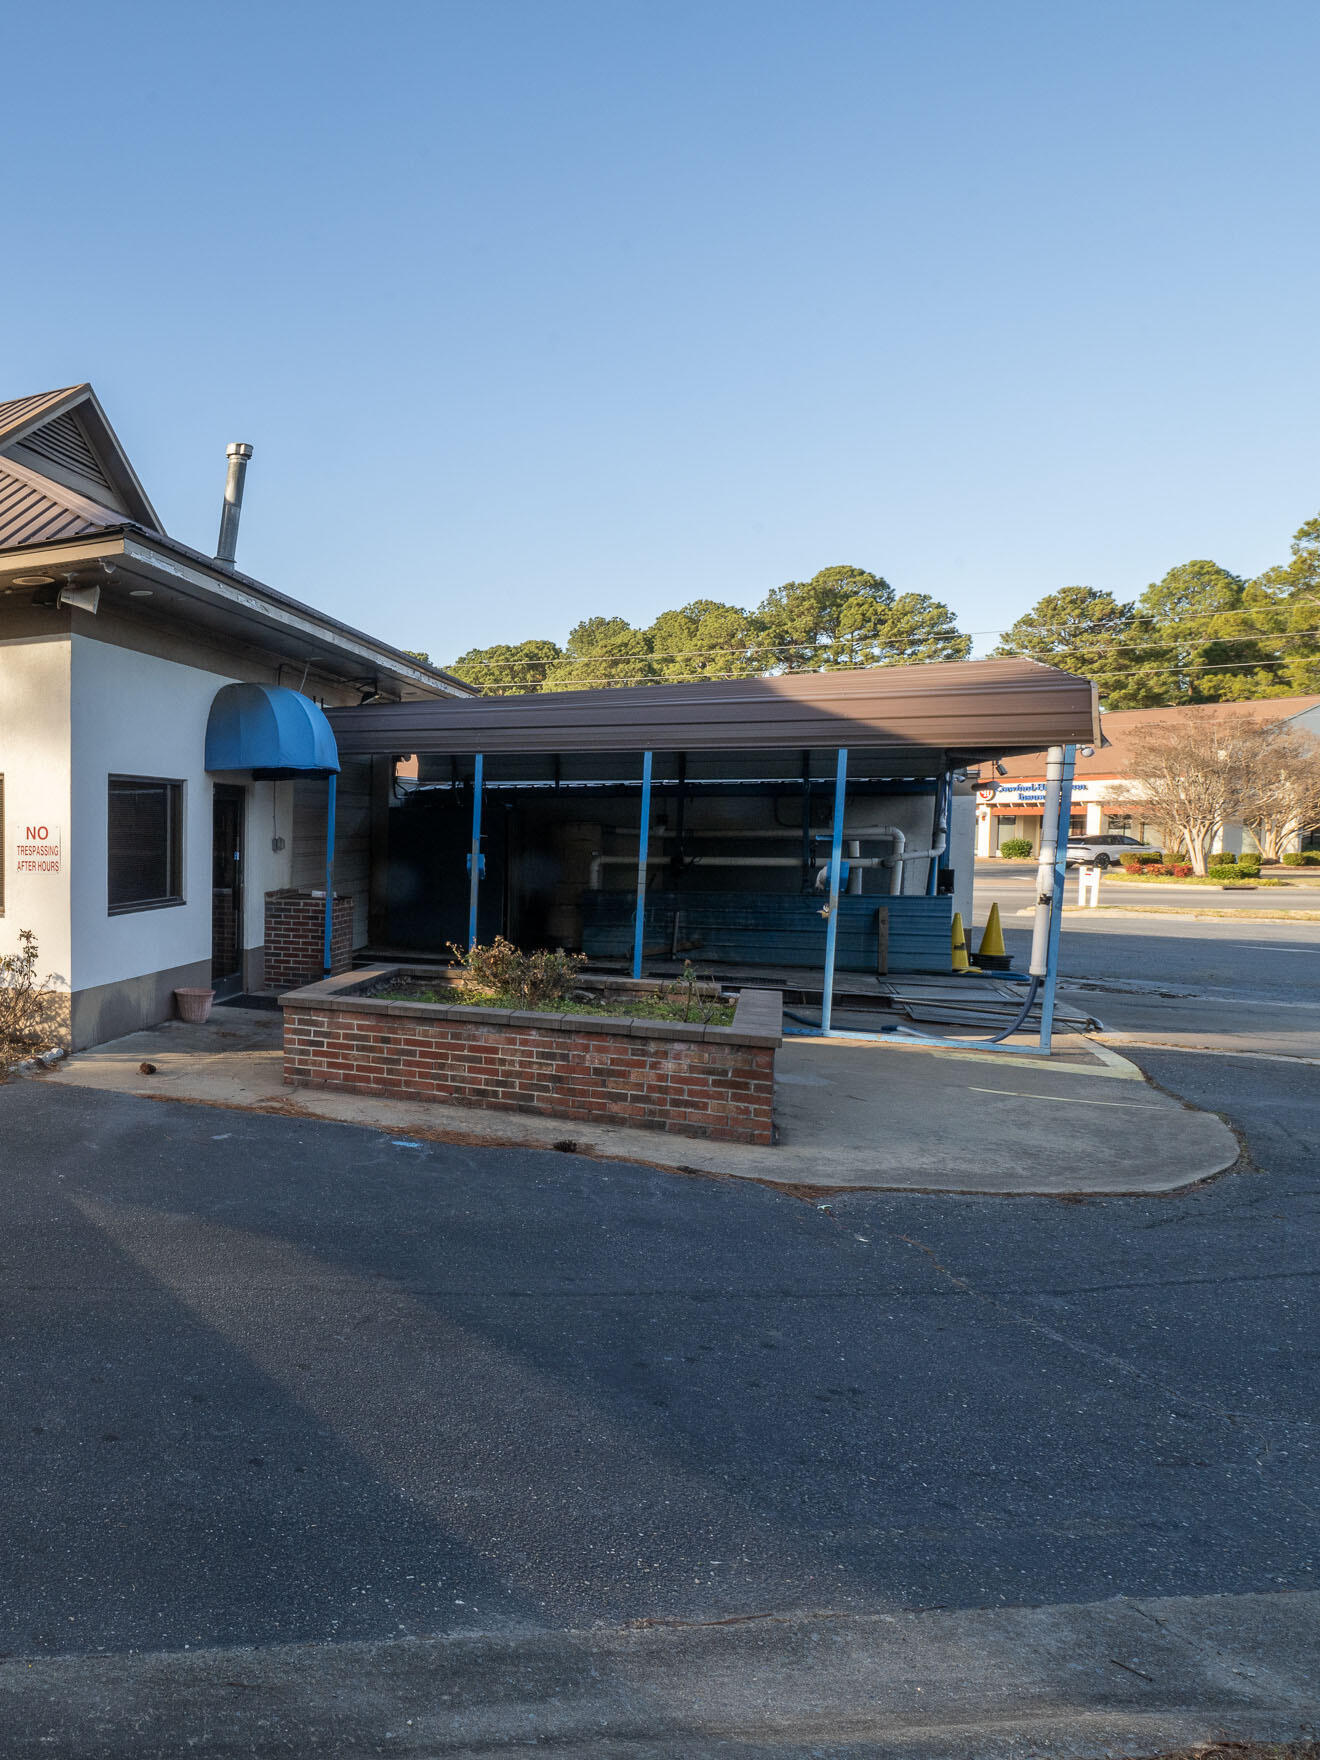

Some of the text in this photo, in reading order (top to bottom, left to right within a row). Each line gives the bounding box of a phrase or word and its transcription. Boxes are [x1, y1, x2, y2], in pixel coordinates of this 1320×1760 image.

[26, 826, 49, 840] NO
[16, 845, 59, 856] TRESPASSING
[17, 861, 60, 872] AFTER HOURS
